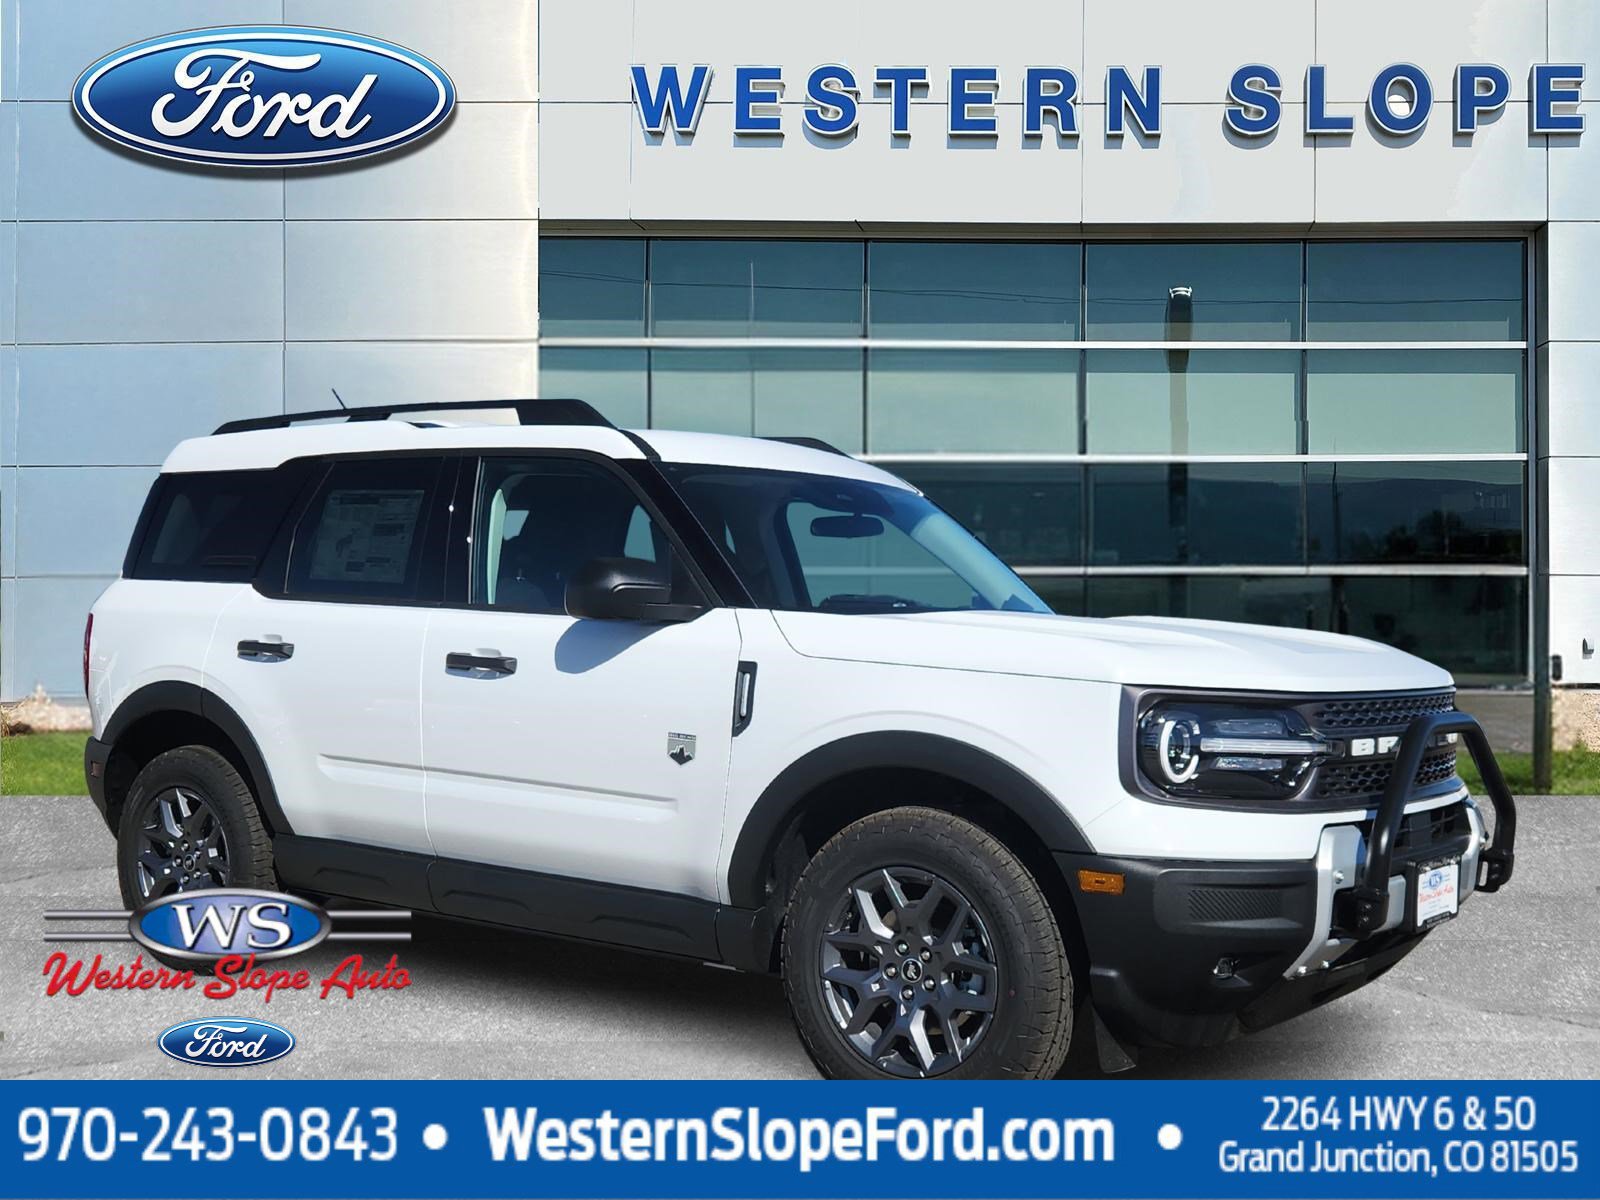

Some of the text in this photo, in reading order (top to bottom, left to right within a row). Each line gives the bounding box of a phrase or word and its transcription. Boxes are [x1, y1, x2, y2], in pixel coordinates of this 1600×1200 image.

[151, 48, 379, 139] Ford
[630, 63, 1587, 135] WESTERN SLOPE
